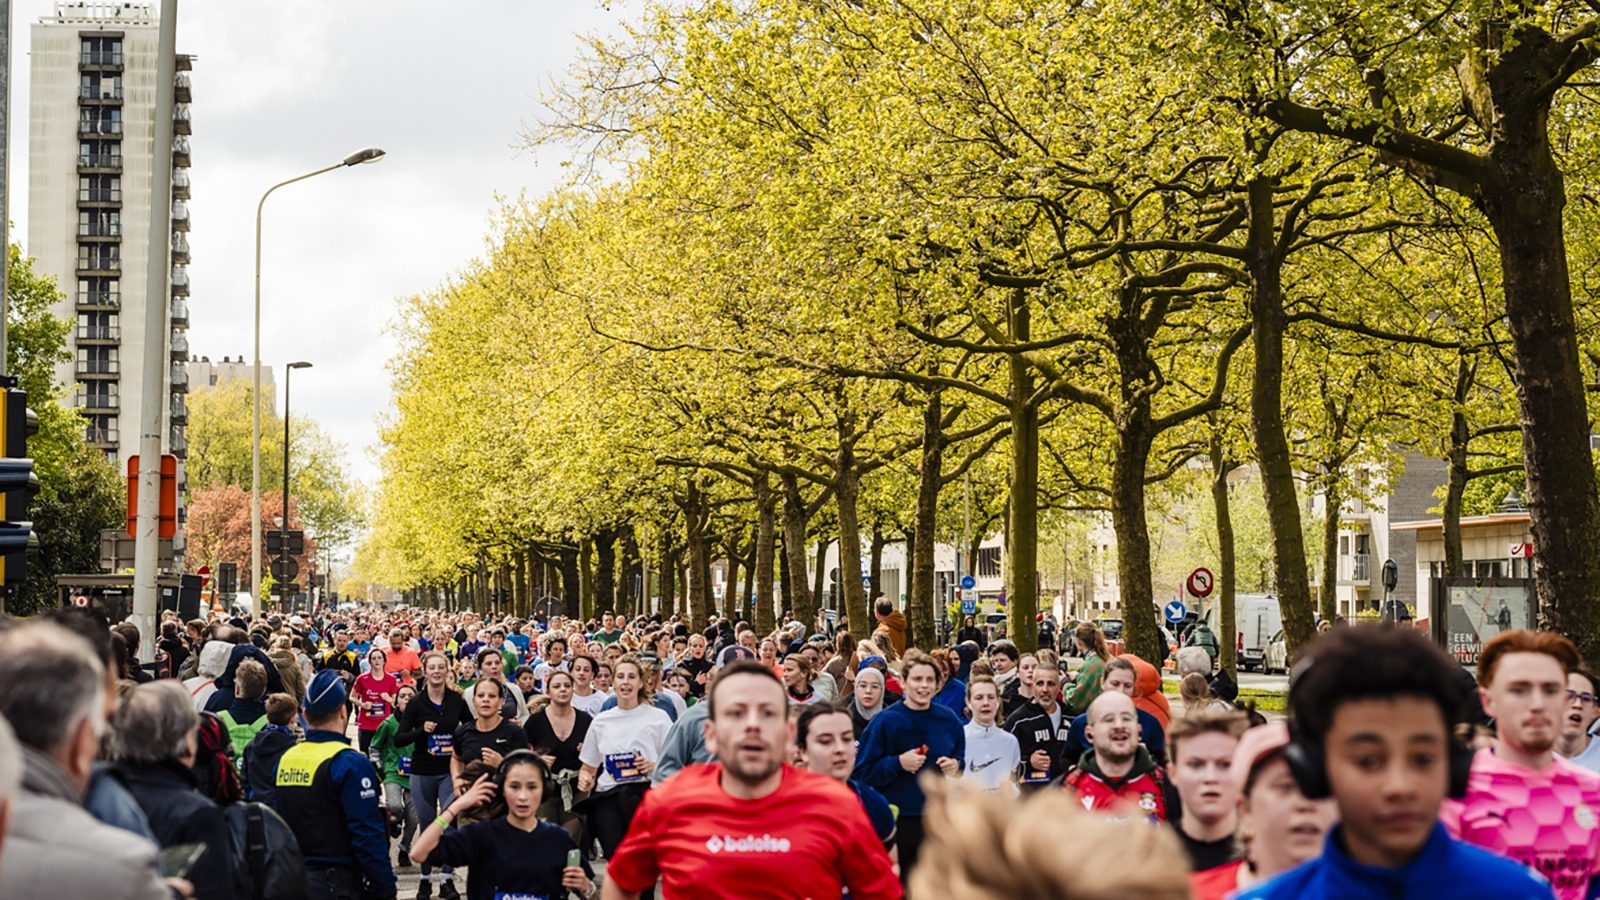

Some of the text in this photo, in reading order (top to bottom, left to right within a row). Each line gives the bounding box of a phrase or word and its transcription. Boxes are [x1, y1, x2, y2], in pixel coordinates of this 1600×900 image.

[1454, 633, 1473, 643] EEN
[1454, 653, 1479, 664] VLUC
[1034, 728, 1068, 742] PUM
[280, 767, 310, 783] Politie
[724, 833, 791, 853] baloise
